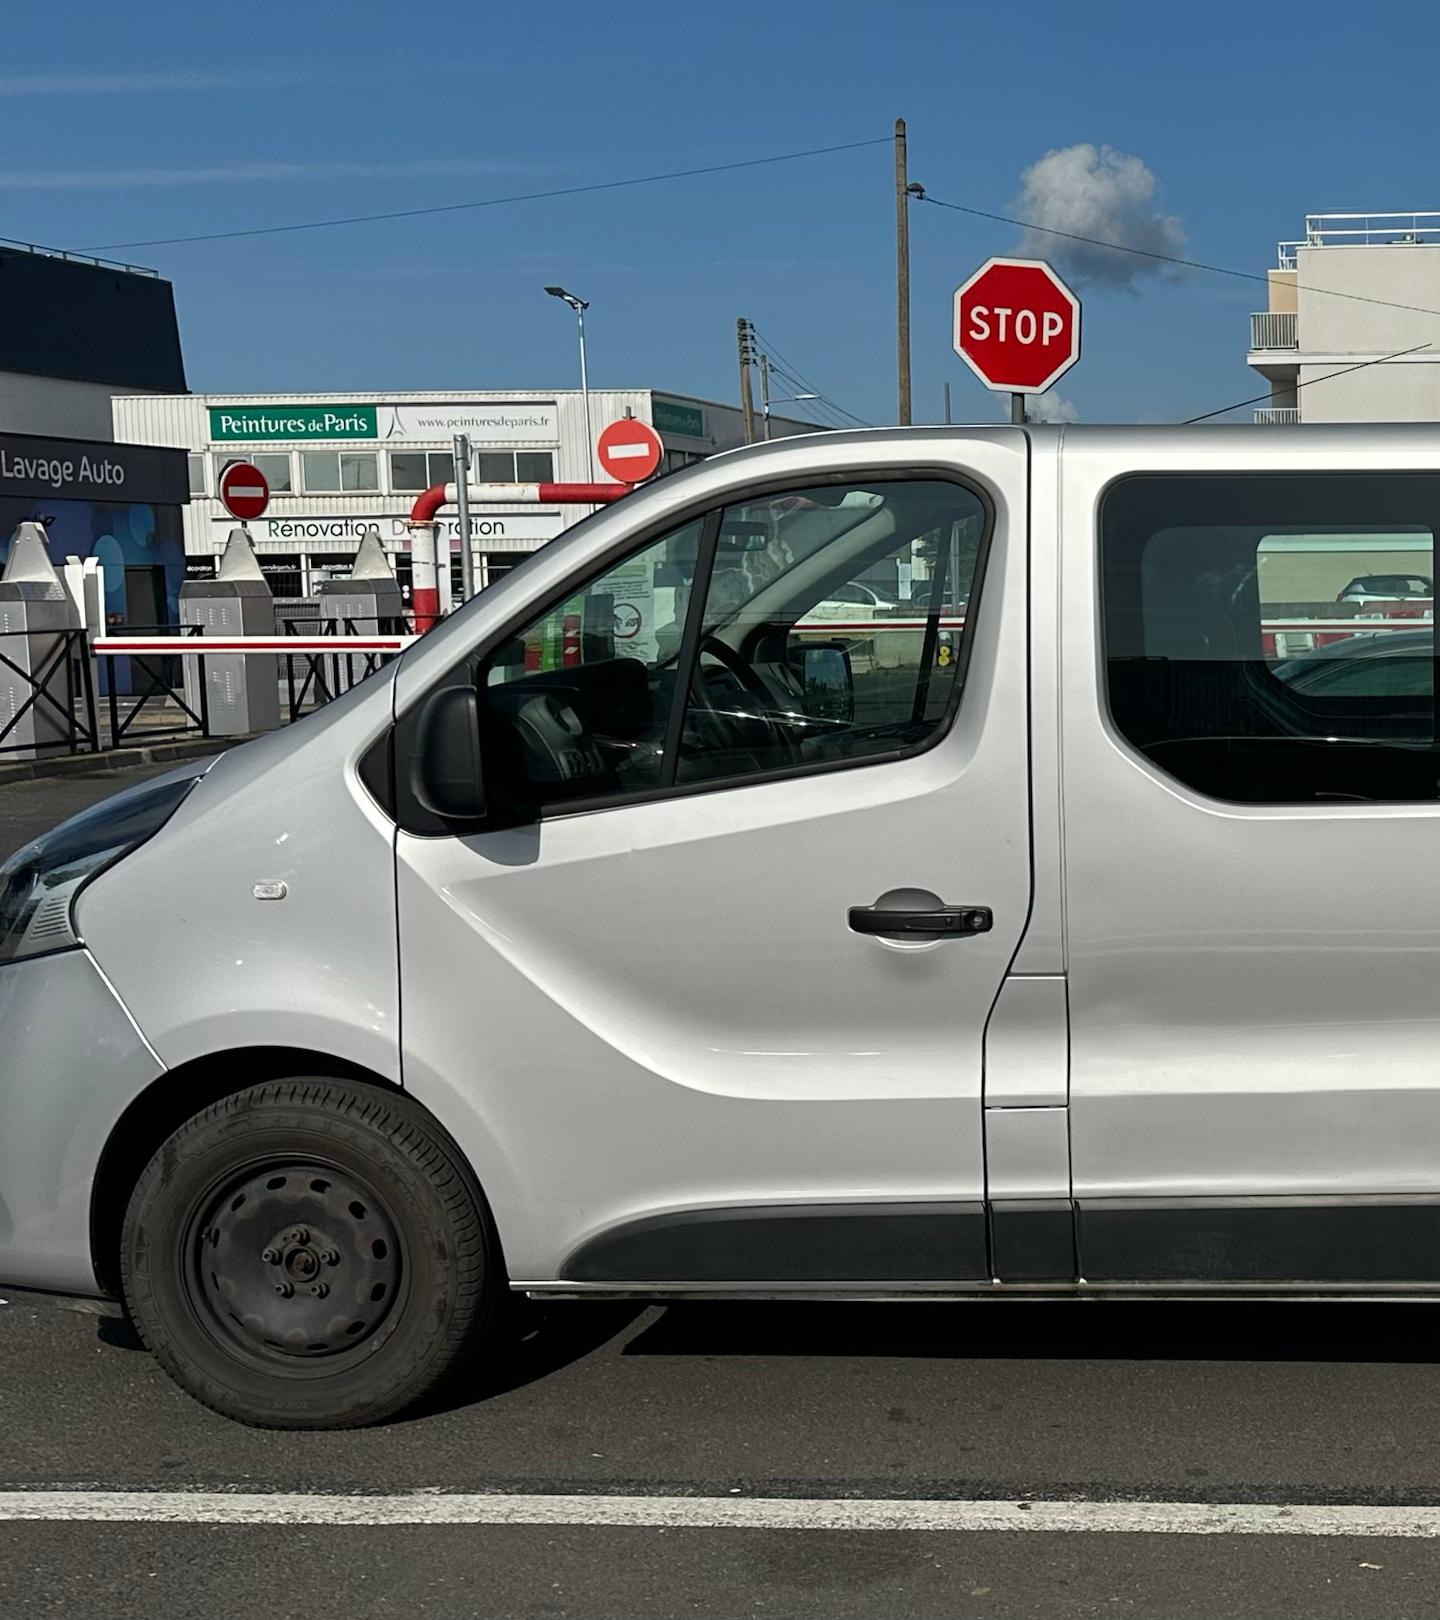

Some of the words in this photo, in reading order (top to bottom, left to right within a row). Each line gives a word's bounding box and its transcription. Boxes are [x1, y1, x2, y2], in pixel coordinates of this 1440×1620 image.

[969, 305, 1064, 346] STOP
[220, 415, 306, 434] Peintures
[307, 419, 324, 432] de
[324, 413, 368, 432] Paris
[417, 416, 550, 429] www.peinturesdeparis.fr
[1, 450, 73, 488] Lavage
[78, 455, 125, 485] Auto
[268, 519, 380, 538] Rénovation
